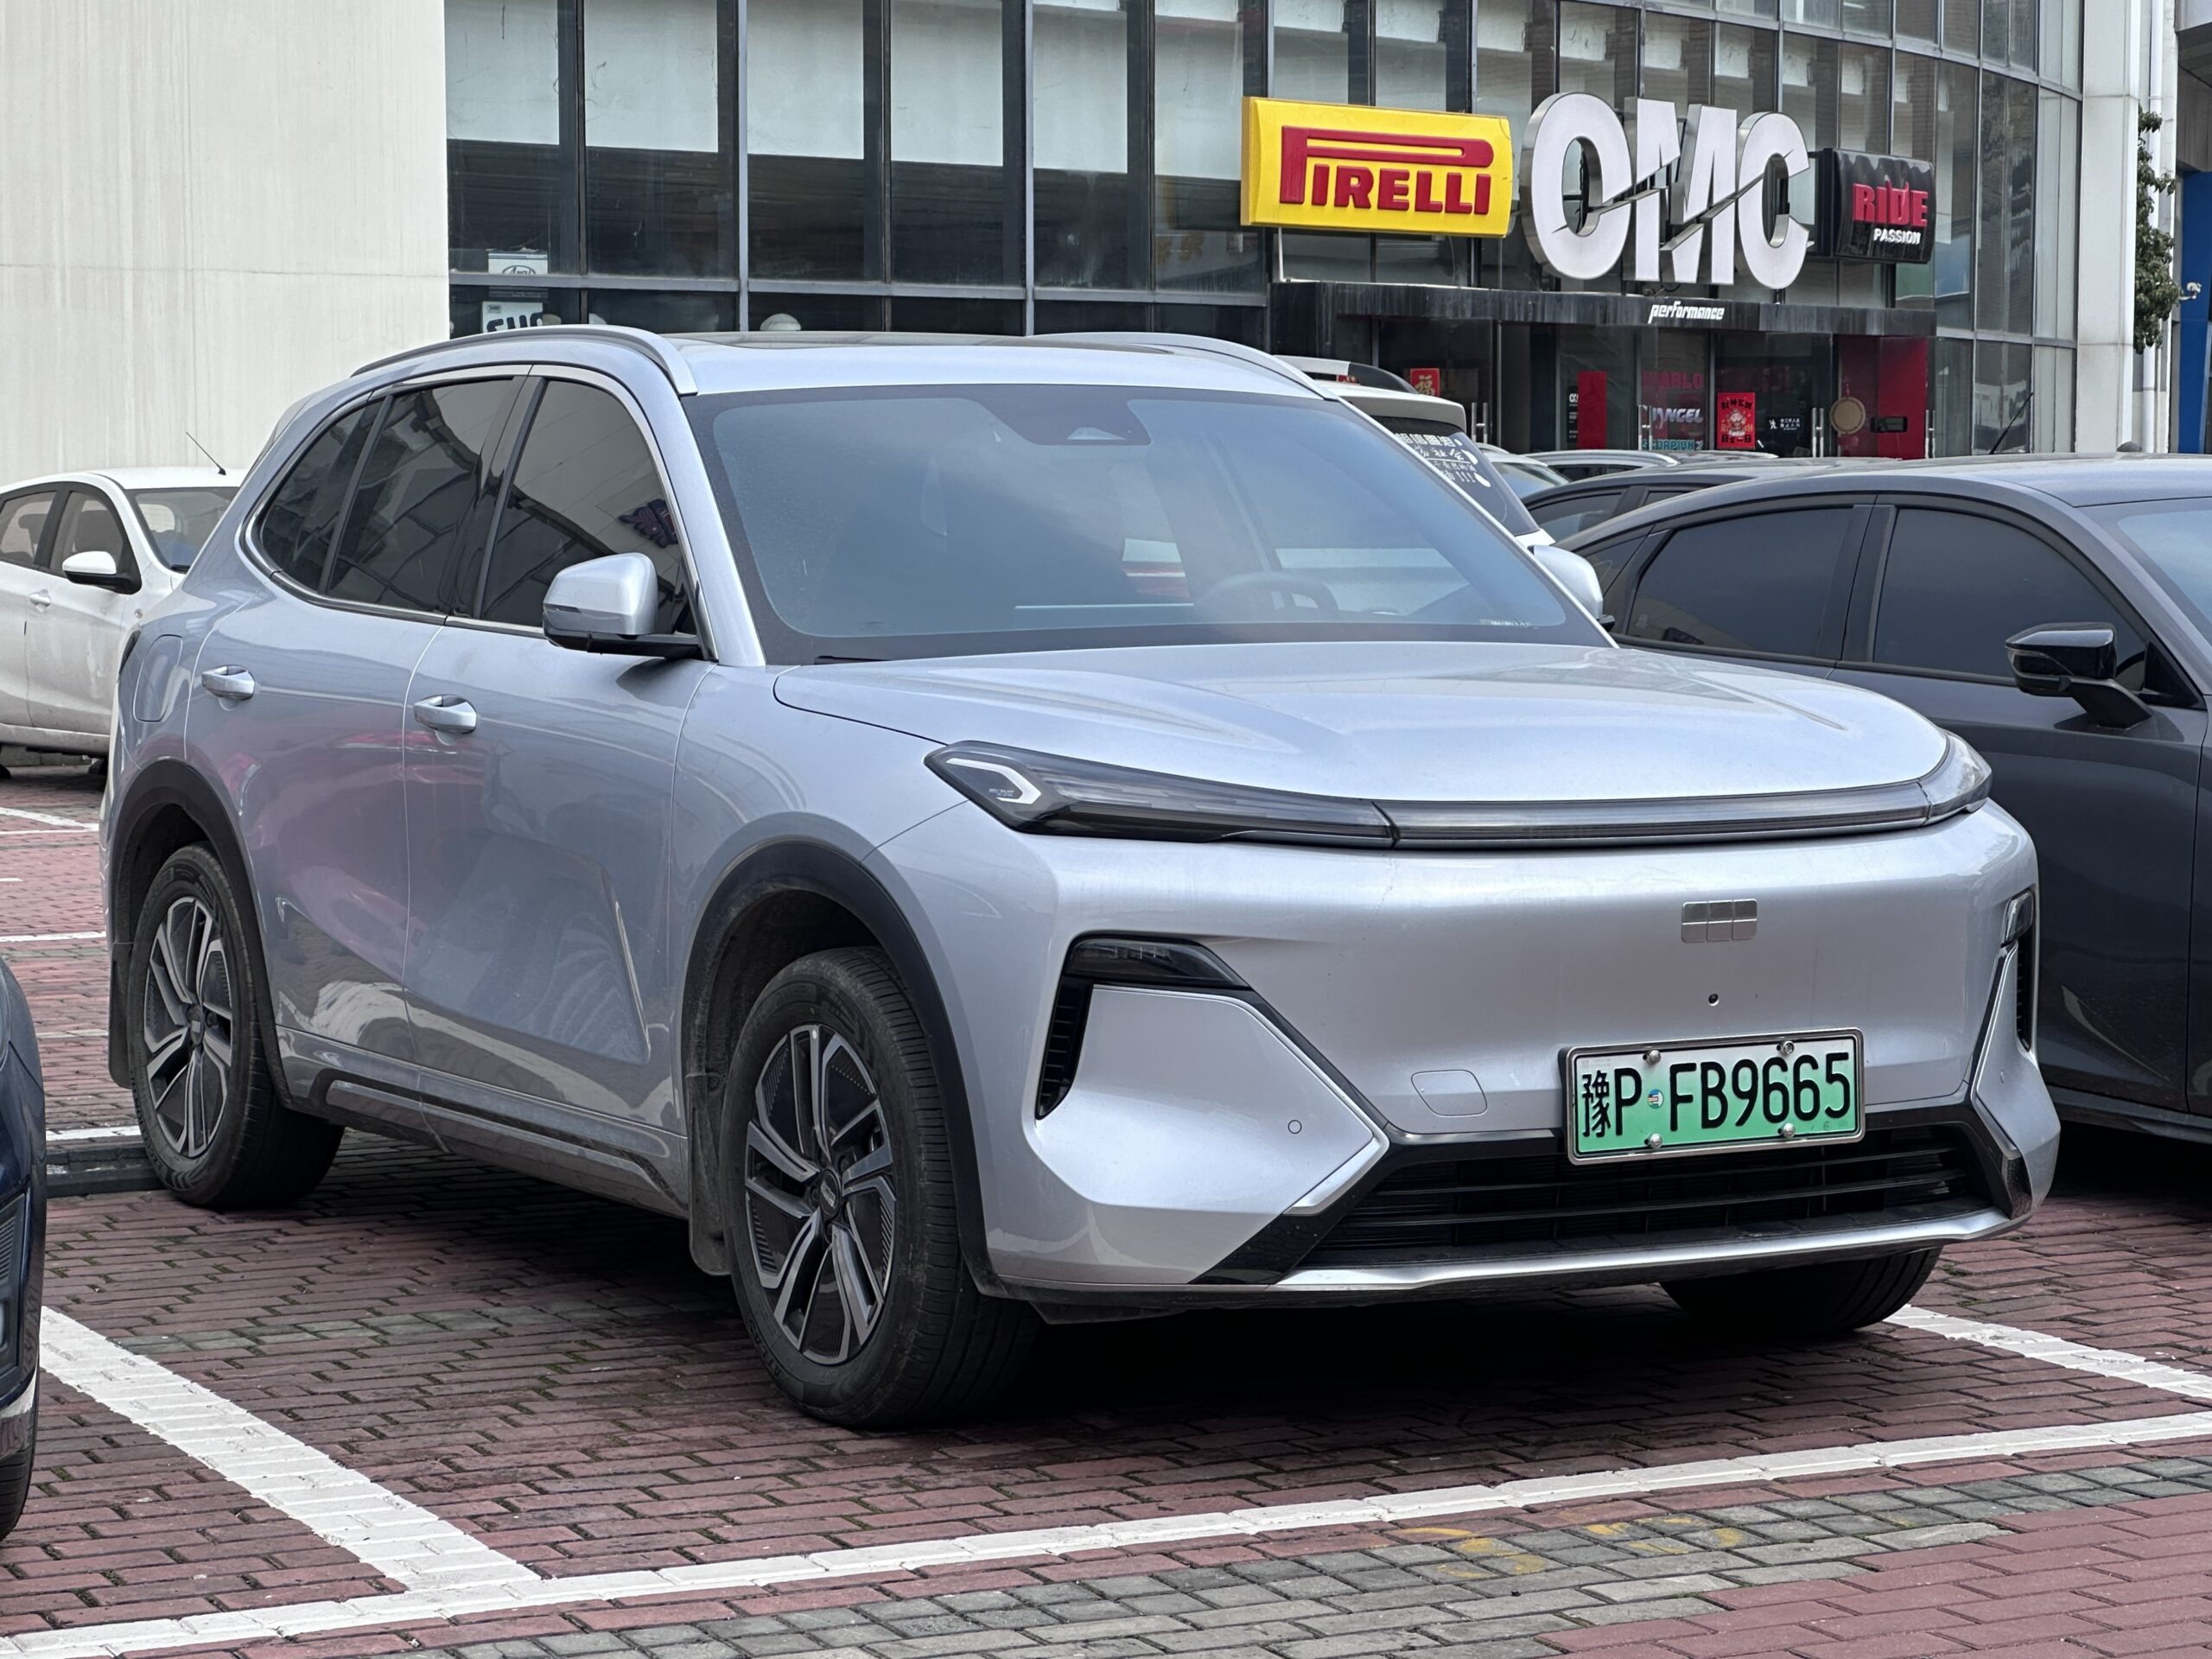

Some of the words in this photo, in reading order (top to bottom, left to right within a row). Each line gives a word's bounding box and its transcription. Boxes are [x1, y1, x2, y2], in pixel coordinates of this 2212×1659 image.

[1280, 125, 1495, 215] PIRELLI
[1521, 91, 1811, 289] OMC
[1853, 177, 1929, 227] RIDE
[1873, 228, 1921, 245] PASSION
[1647, 301, 1725, 324] performance
[1581, 1066, 1642, 1138] 豫P
[1669, 1052, 1851, 1131] FB9665
